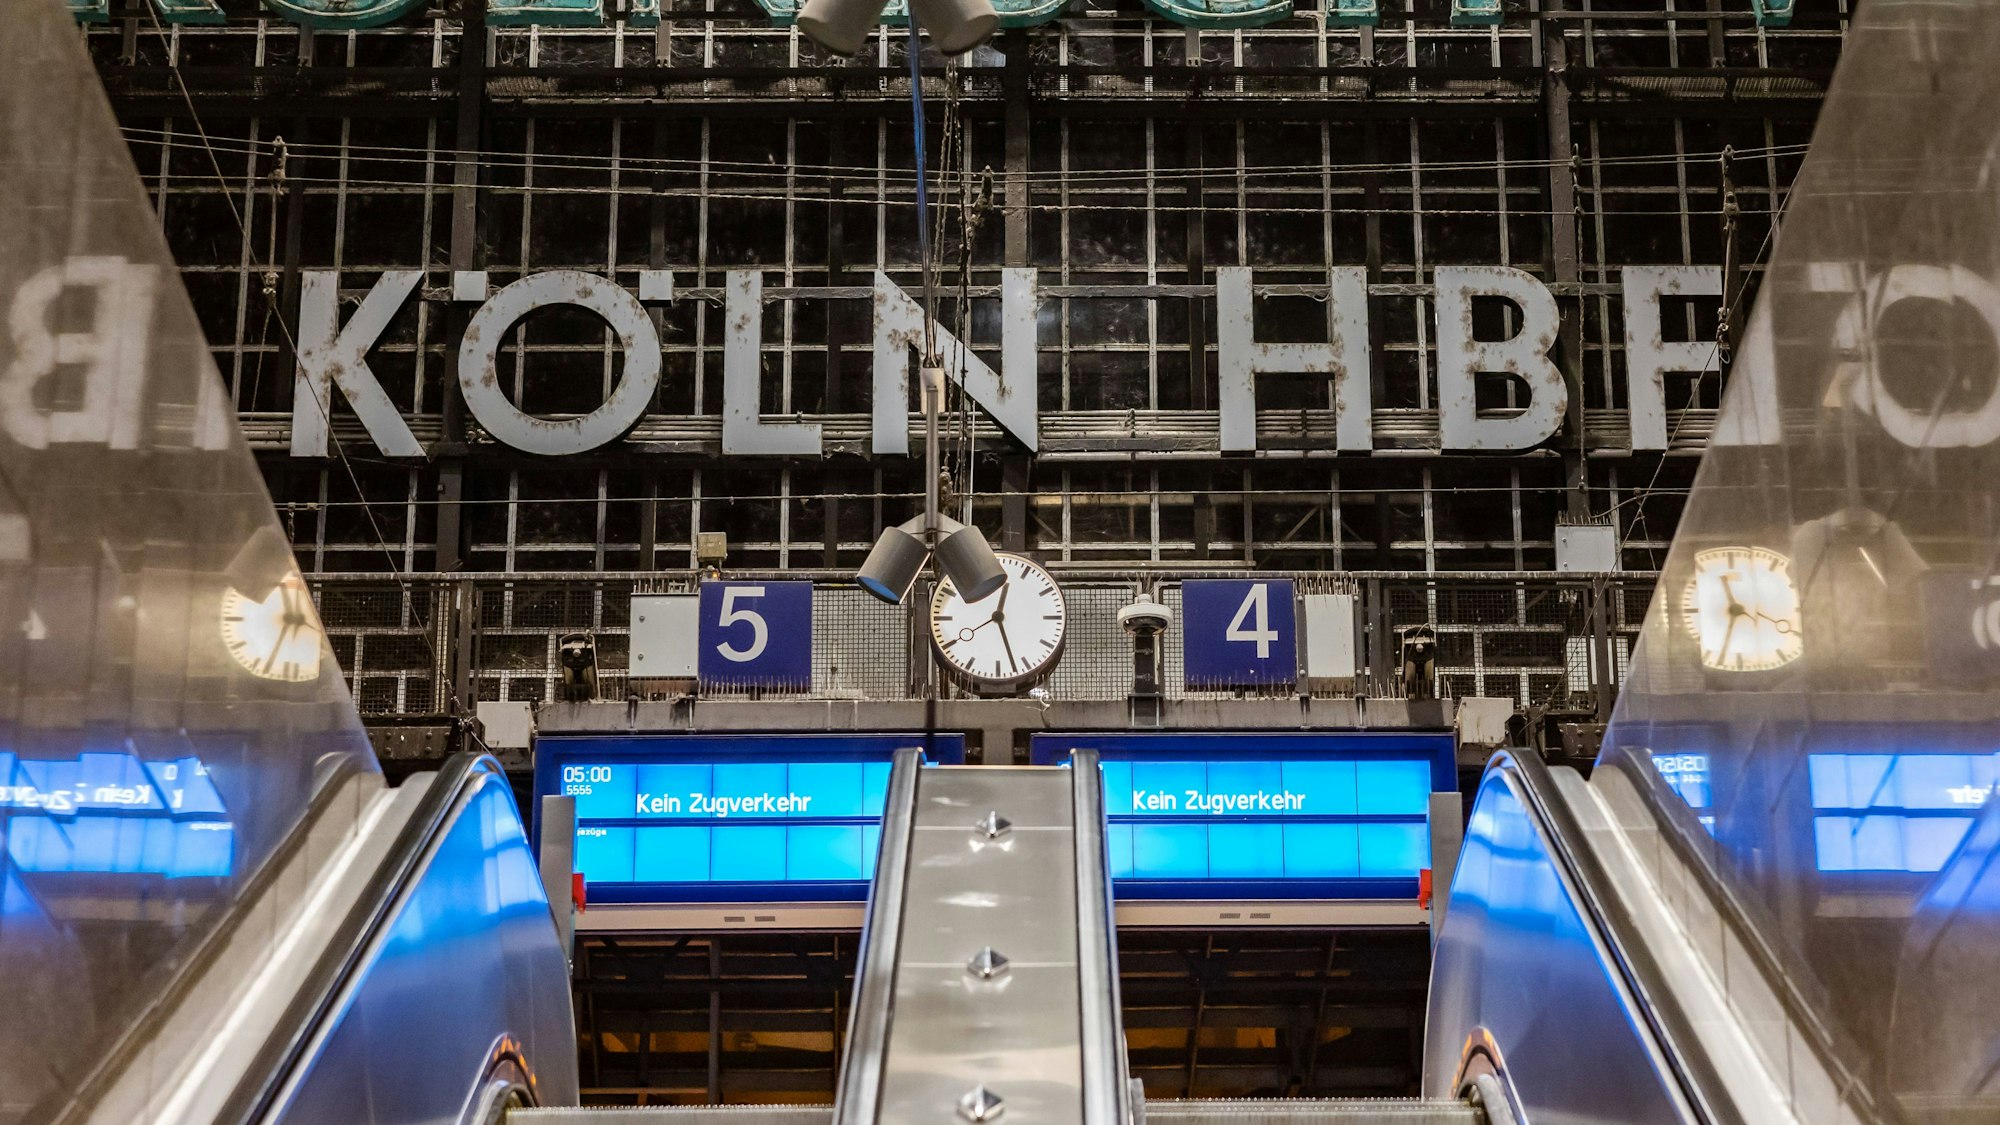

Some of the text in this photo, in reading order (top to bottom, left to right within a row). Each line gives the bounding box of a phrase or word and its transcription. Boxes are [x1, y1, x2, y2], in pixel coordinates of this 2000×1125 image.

[291, 267, 1038, 457] KÖLN
[1216, 266, 1722, 450] HBF
[716, 586, 768, 662] 5
[1225, 584, 1279, 659] 4
[563, 766, 612, 783] 05:00
[566, 784, 593, 796] 5555
[1132, 790, 1306, 815] Kein Zugverkehr
[636, 792, 812, 818] Kein Zugverkehr
